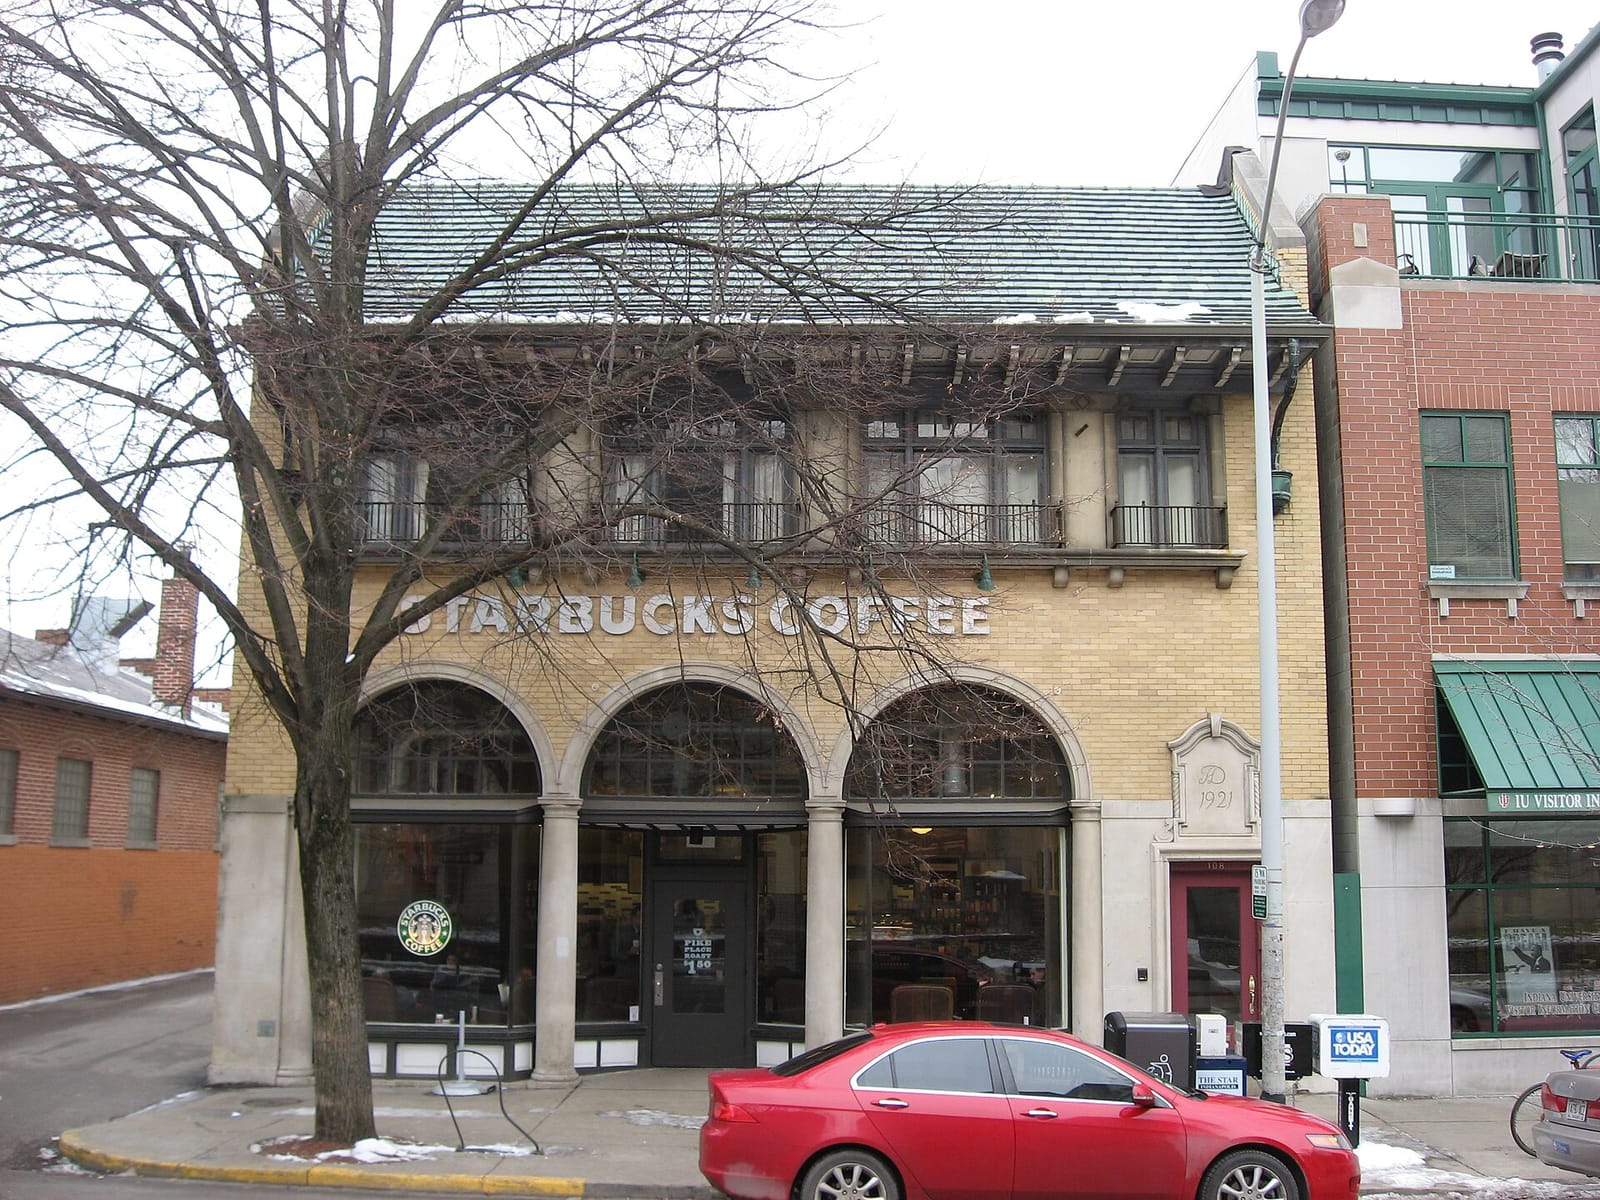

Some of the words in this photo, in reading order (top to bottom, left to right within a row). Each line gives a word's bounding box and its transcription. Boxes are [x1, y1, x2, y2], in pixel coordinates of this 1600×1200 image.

[400, 594, 755, 635] STARBUCKS
[769, 595, 990, 636] COFFEE
[1199, 791, 1233, 809] 1921
[1515, 794, 1530, 808] IU
[1534, 794, 1582, 808] VISITOR
[401, 903, 449, 927] STARBUCKS
[405, 938, 443, 953] COFFEE
[1346, 1032, 1374, 1044] USA
[1333, 1043, 1375, 1056] TODAY
[1198, 1076, 1216, 1084] THE
[1217, 1076, 1239, 1084] STAR
